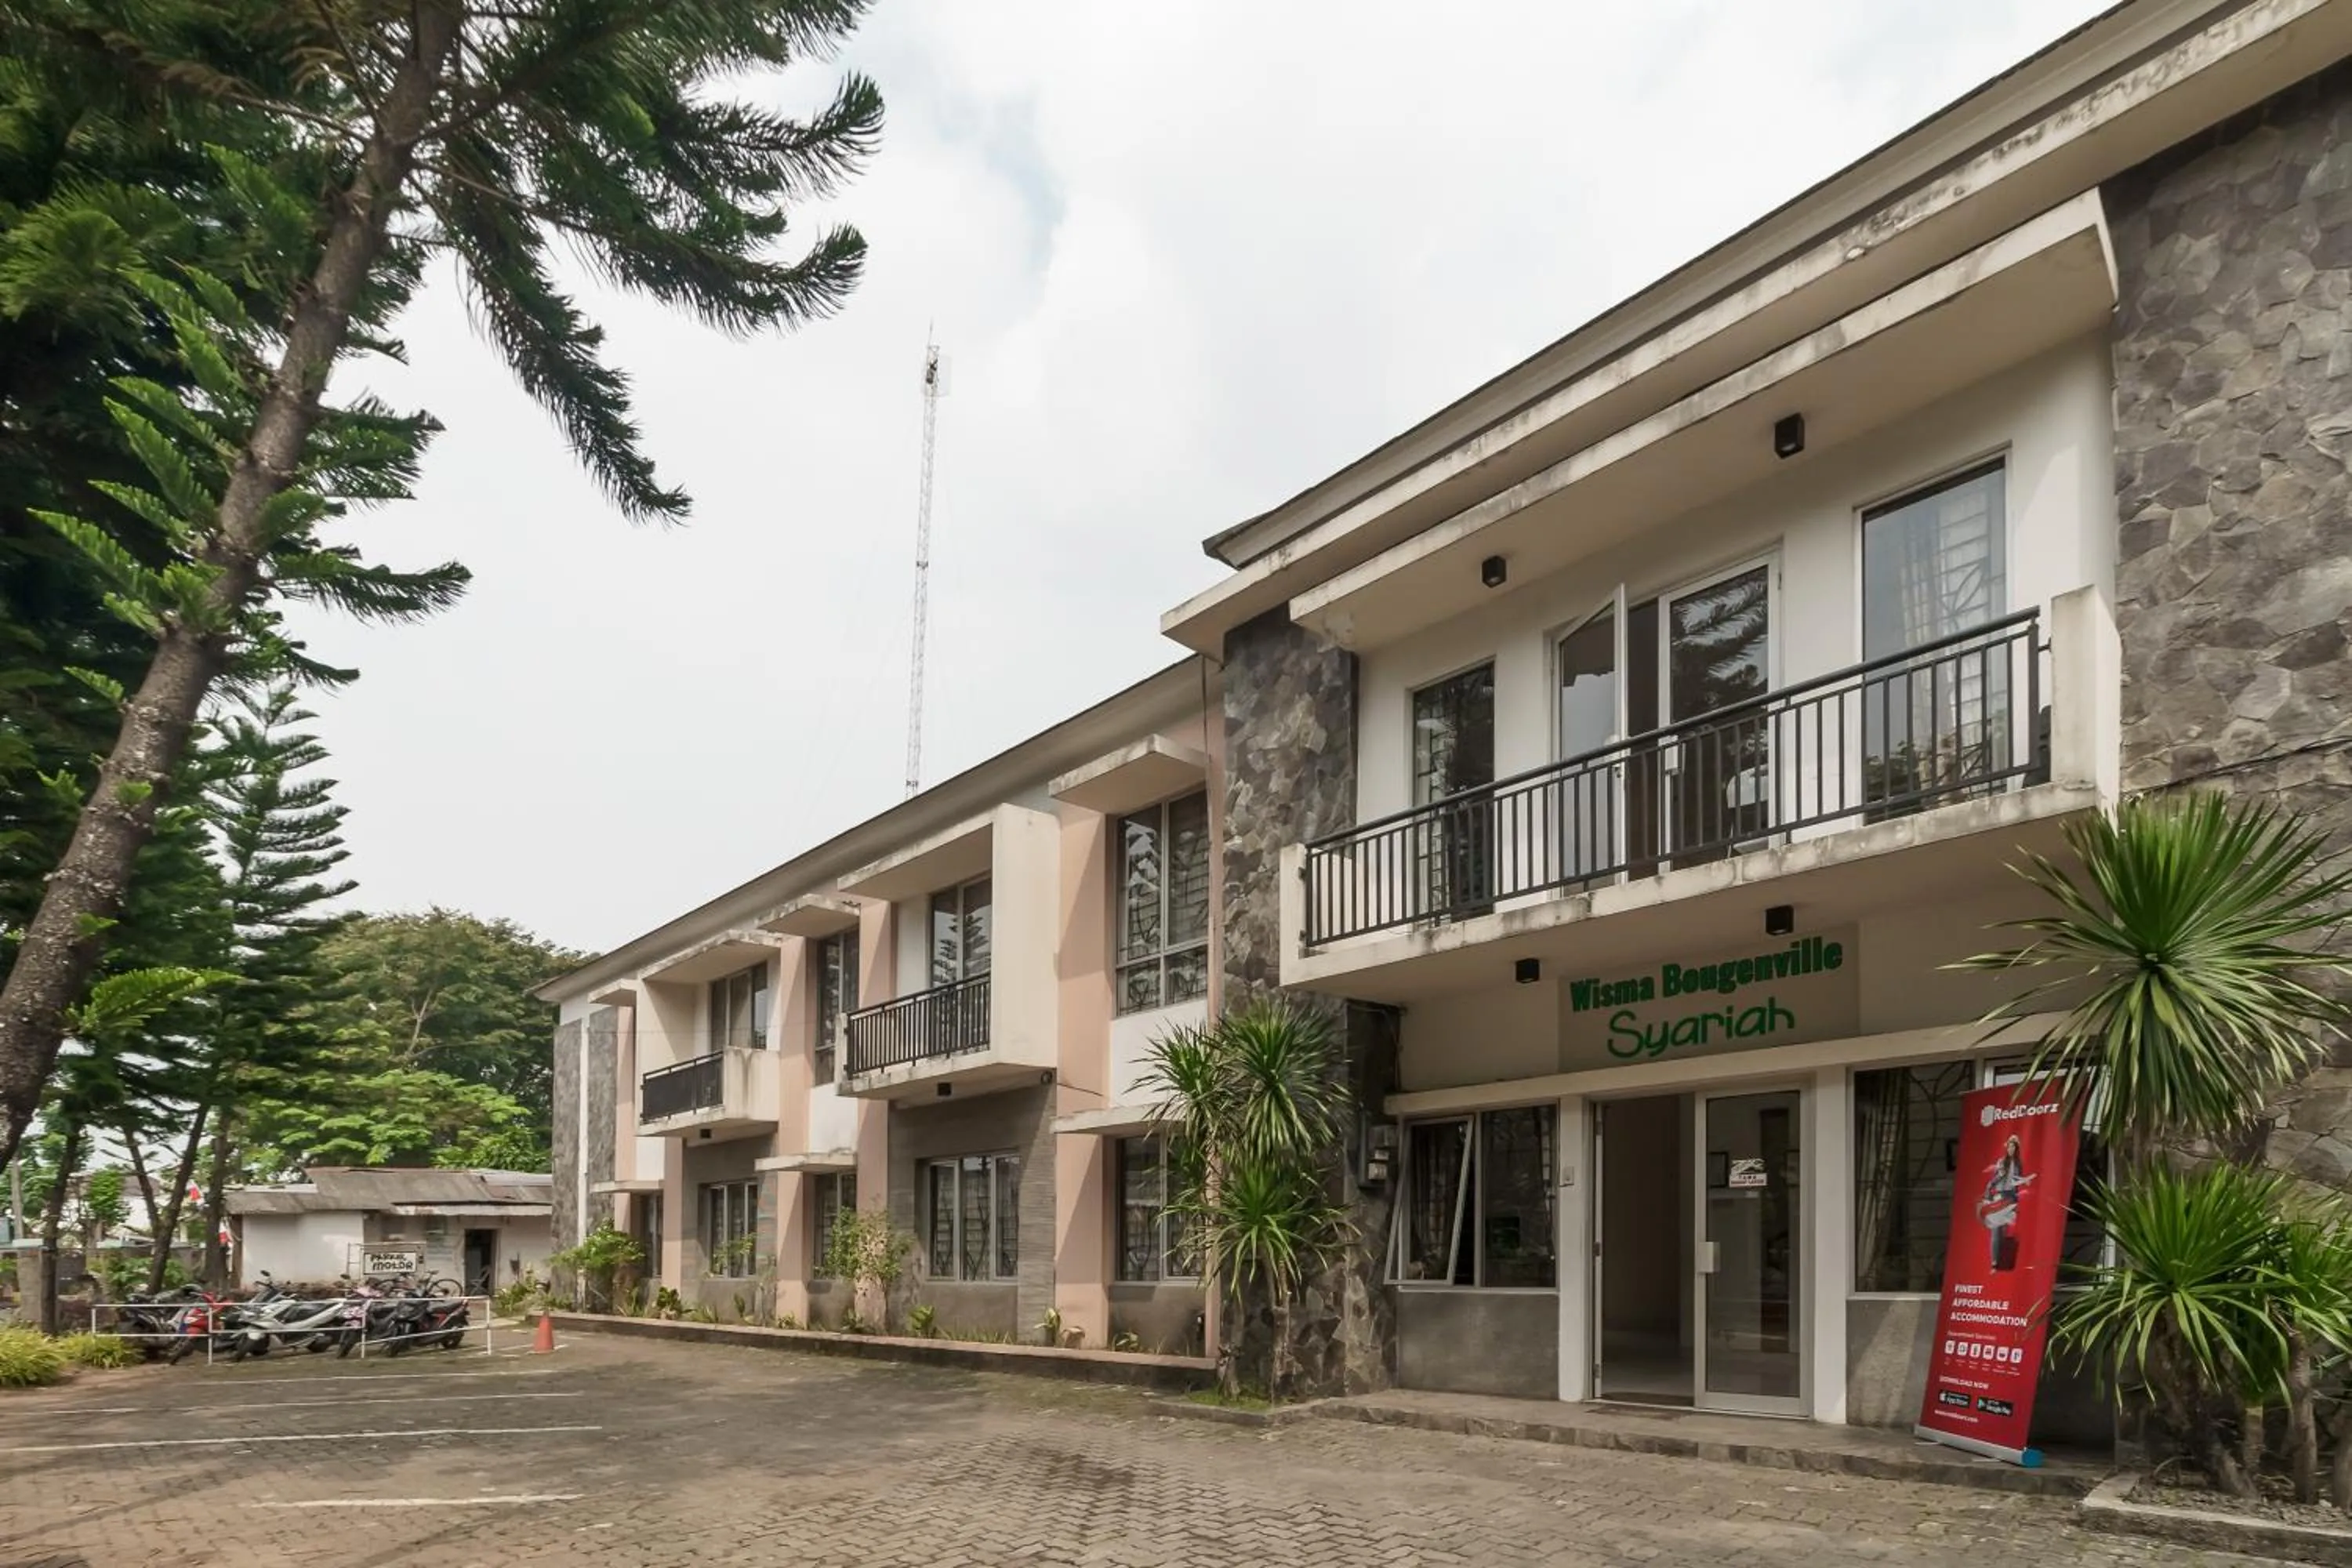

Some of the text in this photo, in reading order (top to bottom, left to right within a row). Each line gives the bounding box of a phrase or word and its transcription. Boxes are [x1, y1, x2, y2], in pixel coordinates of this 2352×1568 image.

[1570, 936, 1843, 1012] Wisma Bougenville
[1607, 996, 1795, 1058] Syariah
[1950, 1312, 2028, 1327] ACCOMMODATION
[1952, 1298, 2009, 1310] AFFORDABLE
